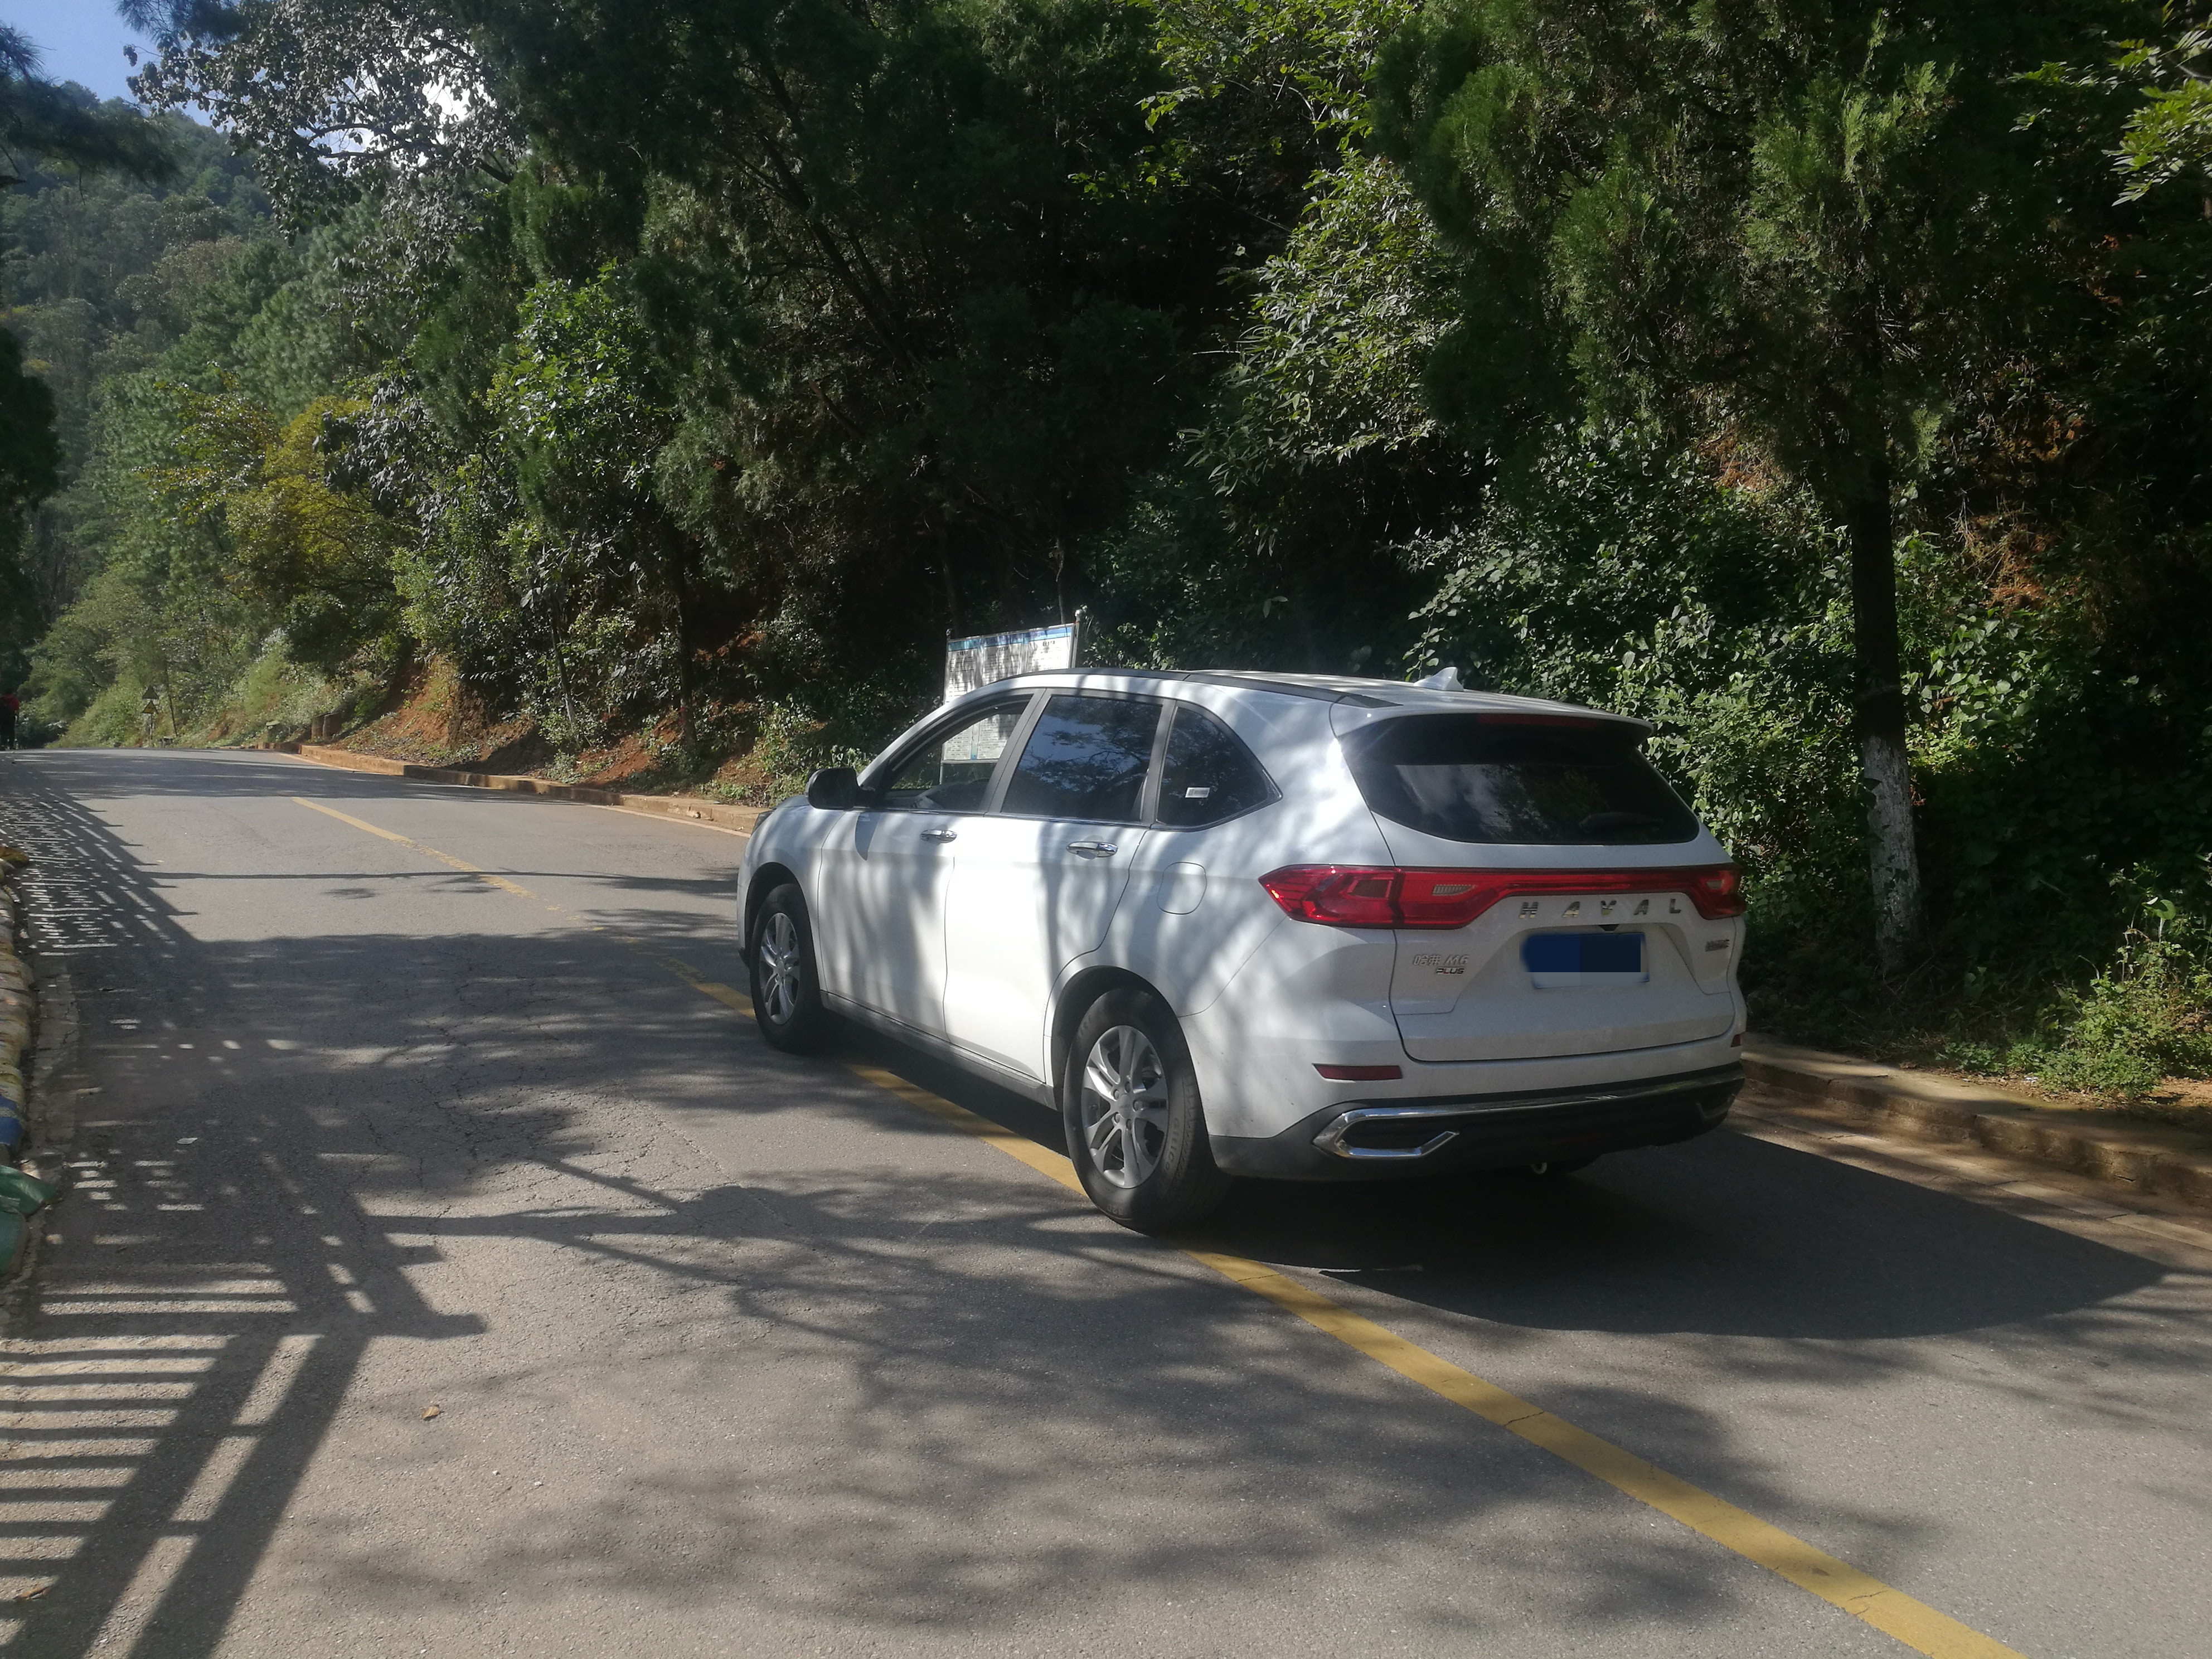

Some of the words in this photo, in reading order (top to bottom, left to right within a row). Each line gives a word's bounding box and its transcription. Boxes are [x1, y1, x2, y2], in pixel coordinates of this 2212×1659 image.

[1518, 898, 1682, 919] HAVAL
[1413, 954, 1441, 966] 哈弗
[1444, 954, 1469, 966] M6
